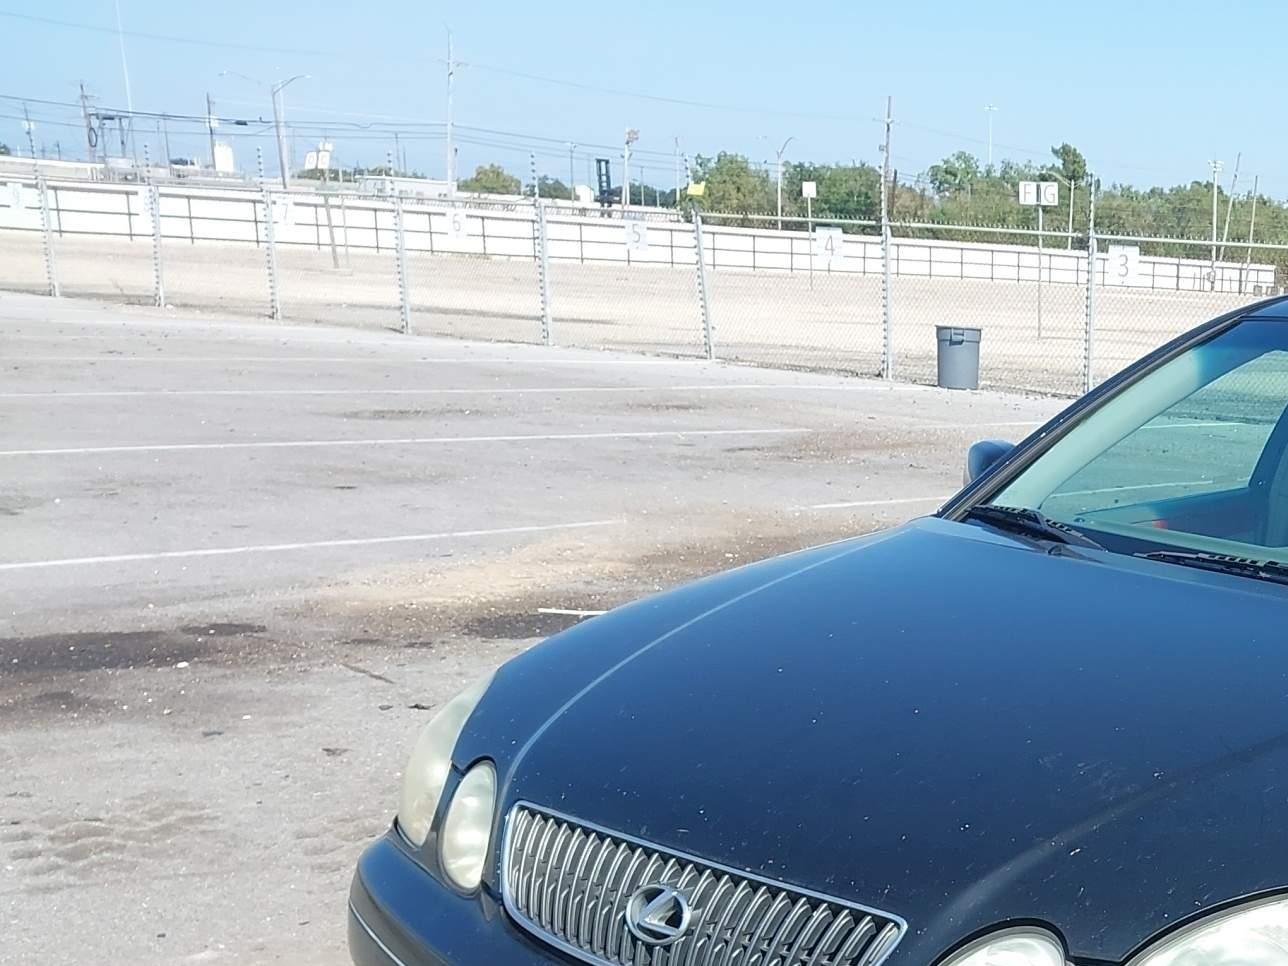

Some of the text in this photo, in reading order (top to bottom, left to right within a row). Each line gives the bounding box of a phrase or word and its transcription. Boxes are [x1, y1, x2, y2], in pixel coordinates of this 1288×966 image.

[1023, 183, 1032, 203] F
[1043, 184, 1056, 204] G
[451, 213, 462, 232] 6
[632, 223, 641, 243] 5
[824, 234, 835, 257] 4
[1118, 254, 1129, 278] 3
